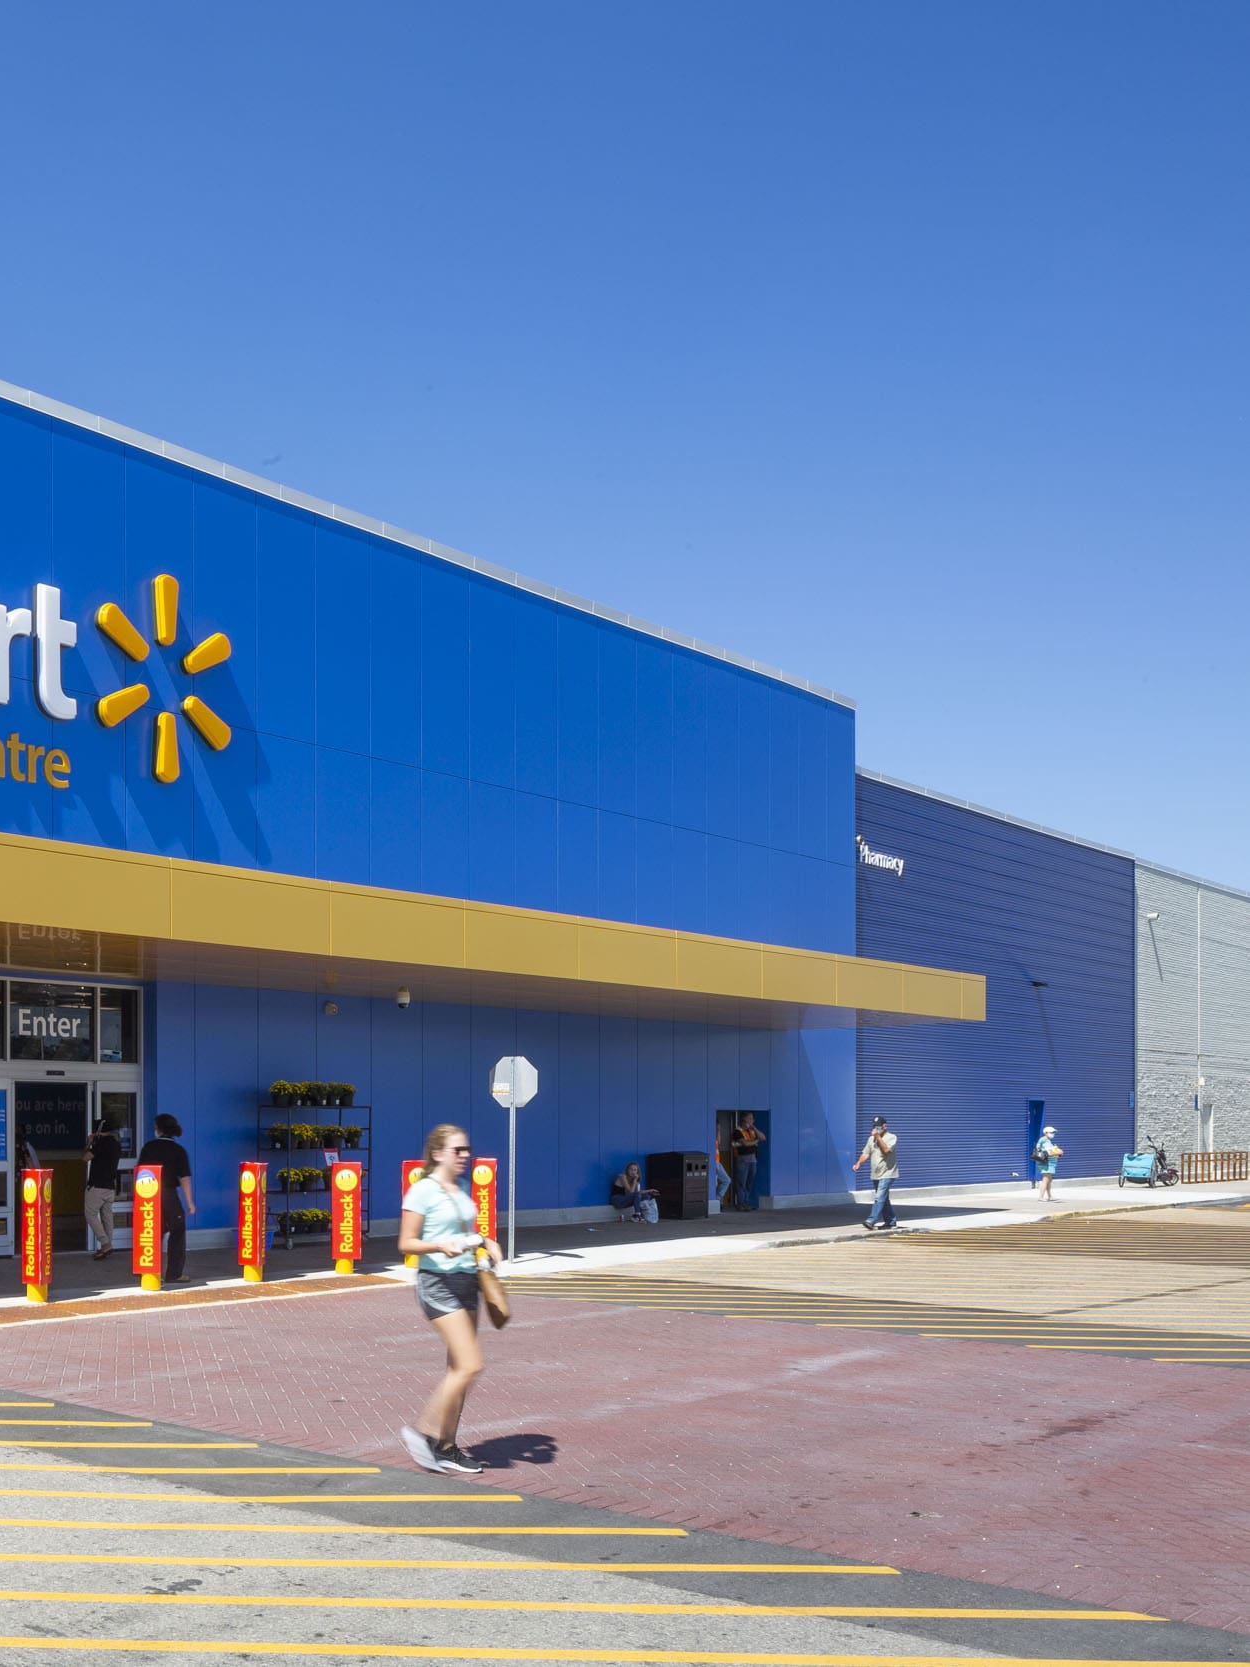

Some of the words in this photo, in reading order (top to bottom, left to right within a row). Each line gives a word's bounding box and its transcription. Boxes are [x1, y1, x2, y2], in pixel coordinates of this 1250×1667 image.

[860, 844, 904, 876] Pharmacy
[18, 1008, 81, 1038] Enter
[16, 1100, 31, 1111] ou
[34, 1100, 54, 1111] are
[36, 1123, 50, 1134] on
[25, 1207, 35, 1277] Rollback
[140, 1201, 154, 1267] Rollback
[242, 1197, 253, 1259] Rollback
[339, 1194, 353, 1253] Rollback
